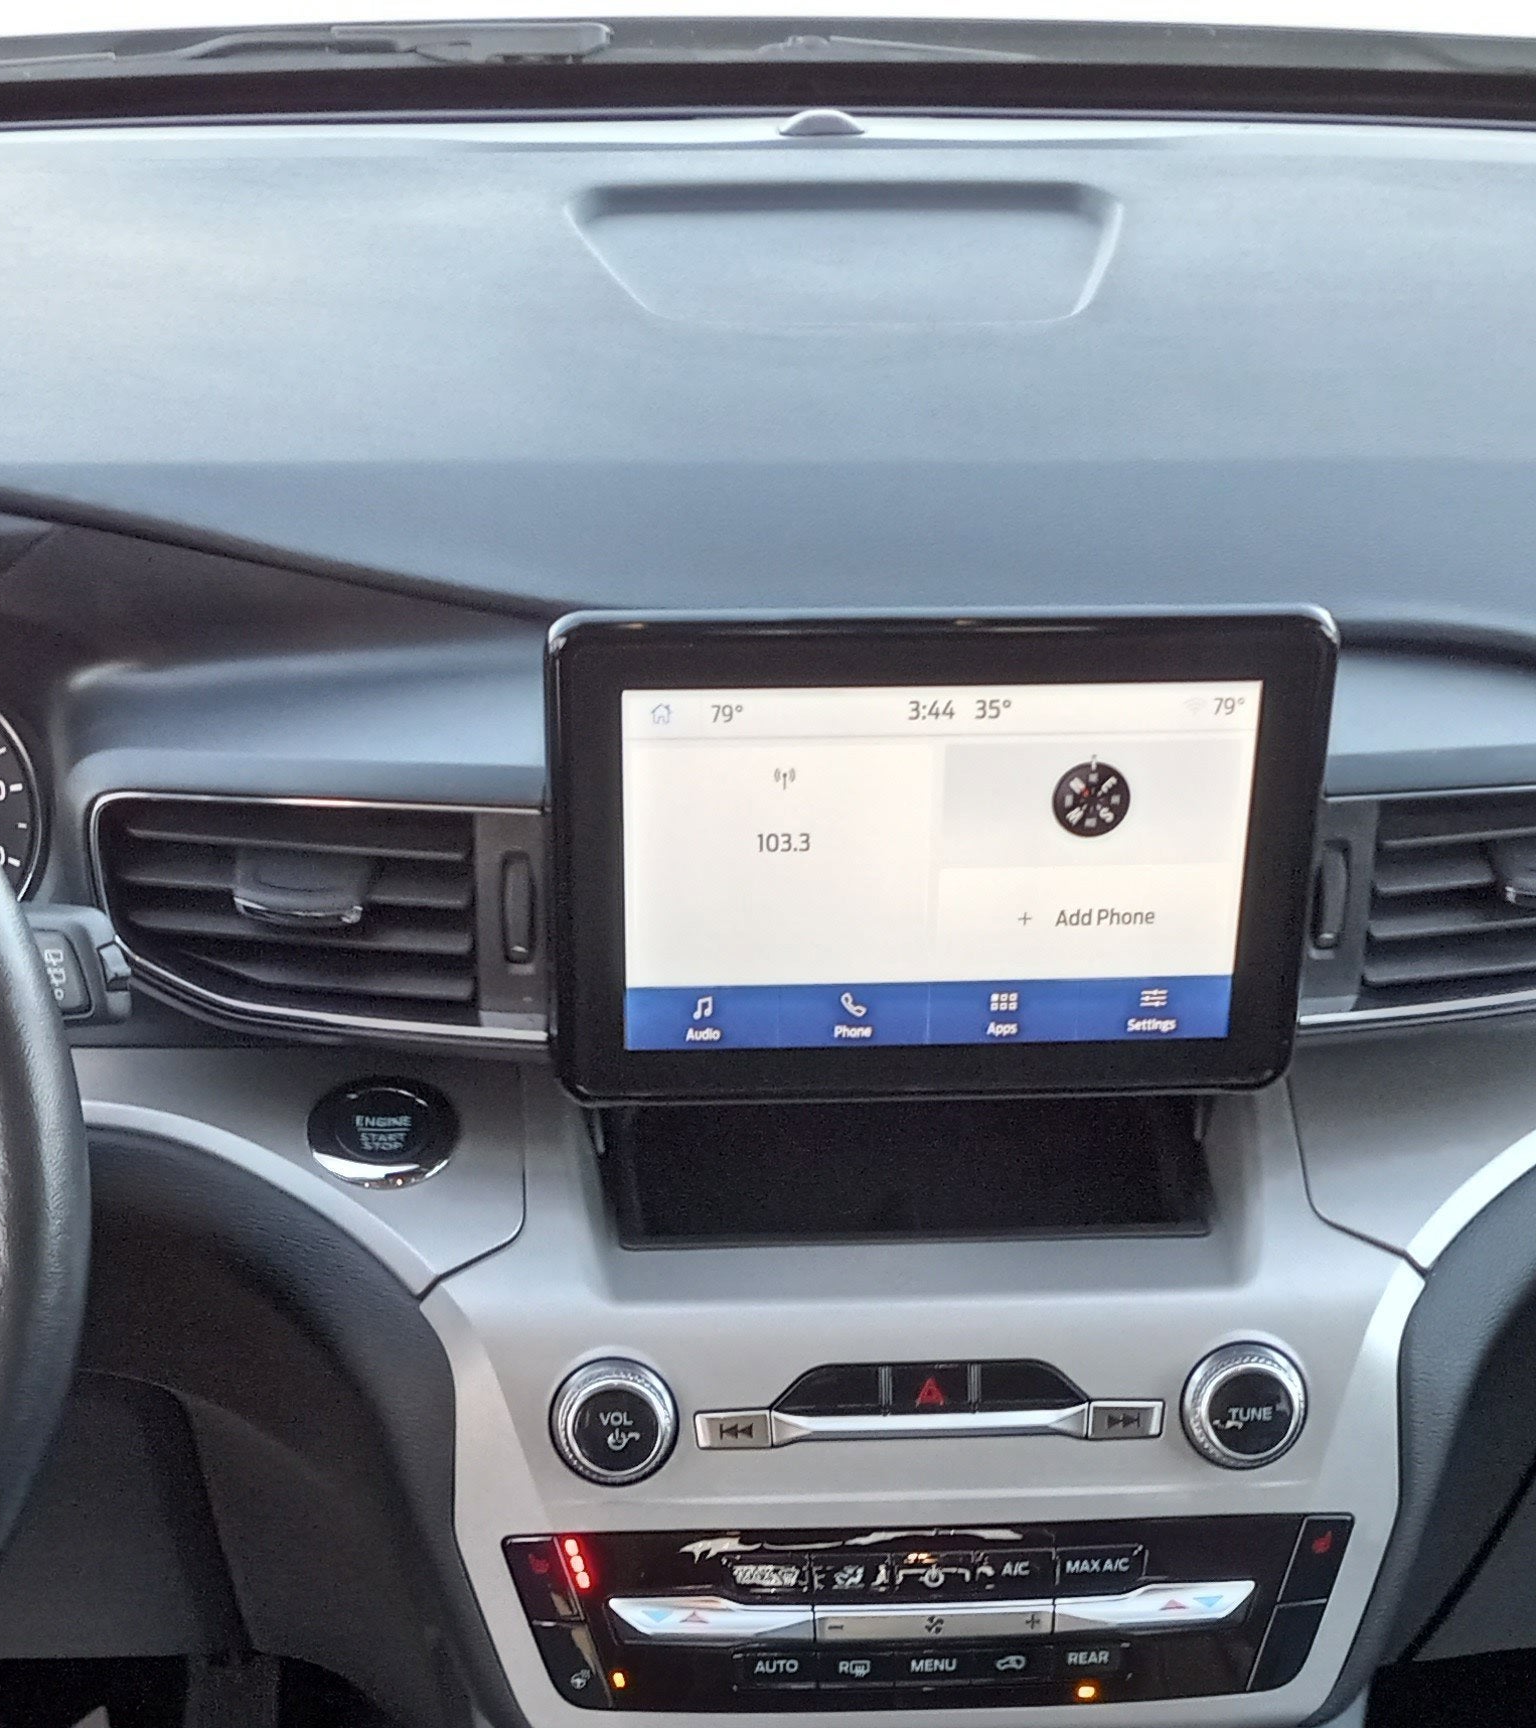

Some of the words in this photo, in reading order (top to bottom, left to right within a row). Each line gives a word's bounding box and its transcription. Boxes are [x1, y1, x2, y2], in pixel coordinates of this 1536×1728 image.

[711, 704, 744, 723] 79°
[908, 700, 955, 720] 3:44
[974, 699, 1012, 719] 35°
[1214, 697, 1245, 715] 79°
[758, 833, 811, 852] 103.3
[1055, 909, 1092, 927] Add
[1097, 908, 1155, 926] Phone
[834, 1024, 872, 1039] Phone
[986, 1022, 1017, 1036] Apps
[1127, 1018, 1177, 1033] Settings
[686, 1028, 721, 1042] Audio
[355, 1115, 412, 1127] ENGINE
[360, 1133, 407, 1142] START
[361, 1142, 404, 1151] STOP
[599, 1411, 634, 1426] VOL
[1228, 1406, 1273, 1421] TUNE
[1001, 1560, 1030, 1576] A/C
[1065, 1559, 1101, 1575] MAX
[1103, 1557, 1131, 1573] A/C
[910, 1658, 957, 1673] MENU
[1067, 1650, 1109, 1666] REAR
[754, 1659, 799, 1674] AUTO
